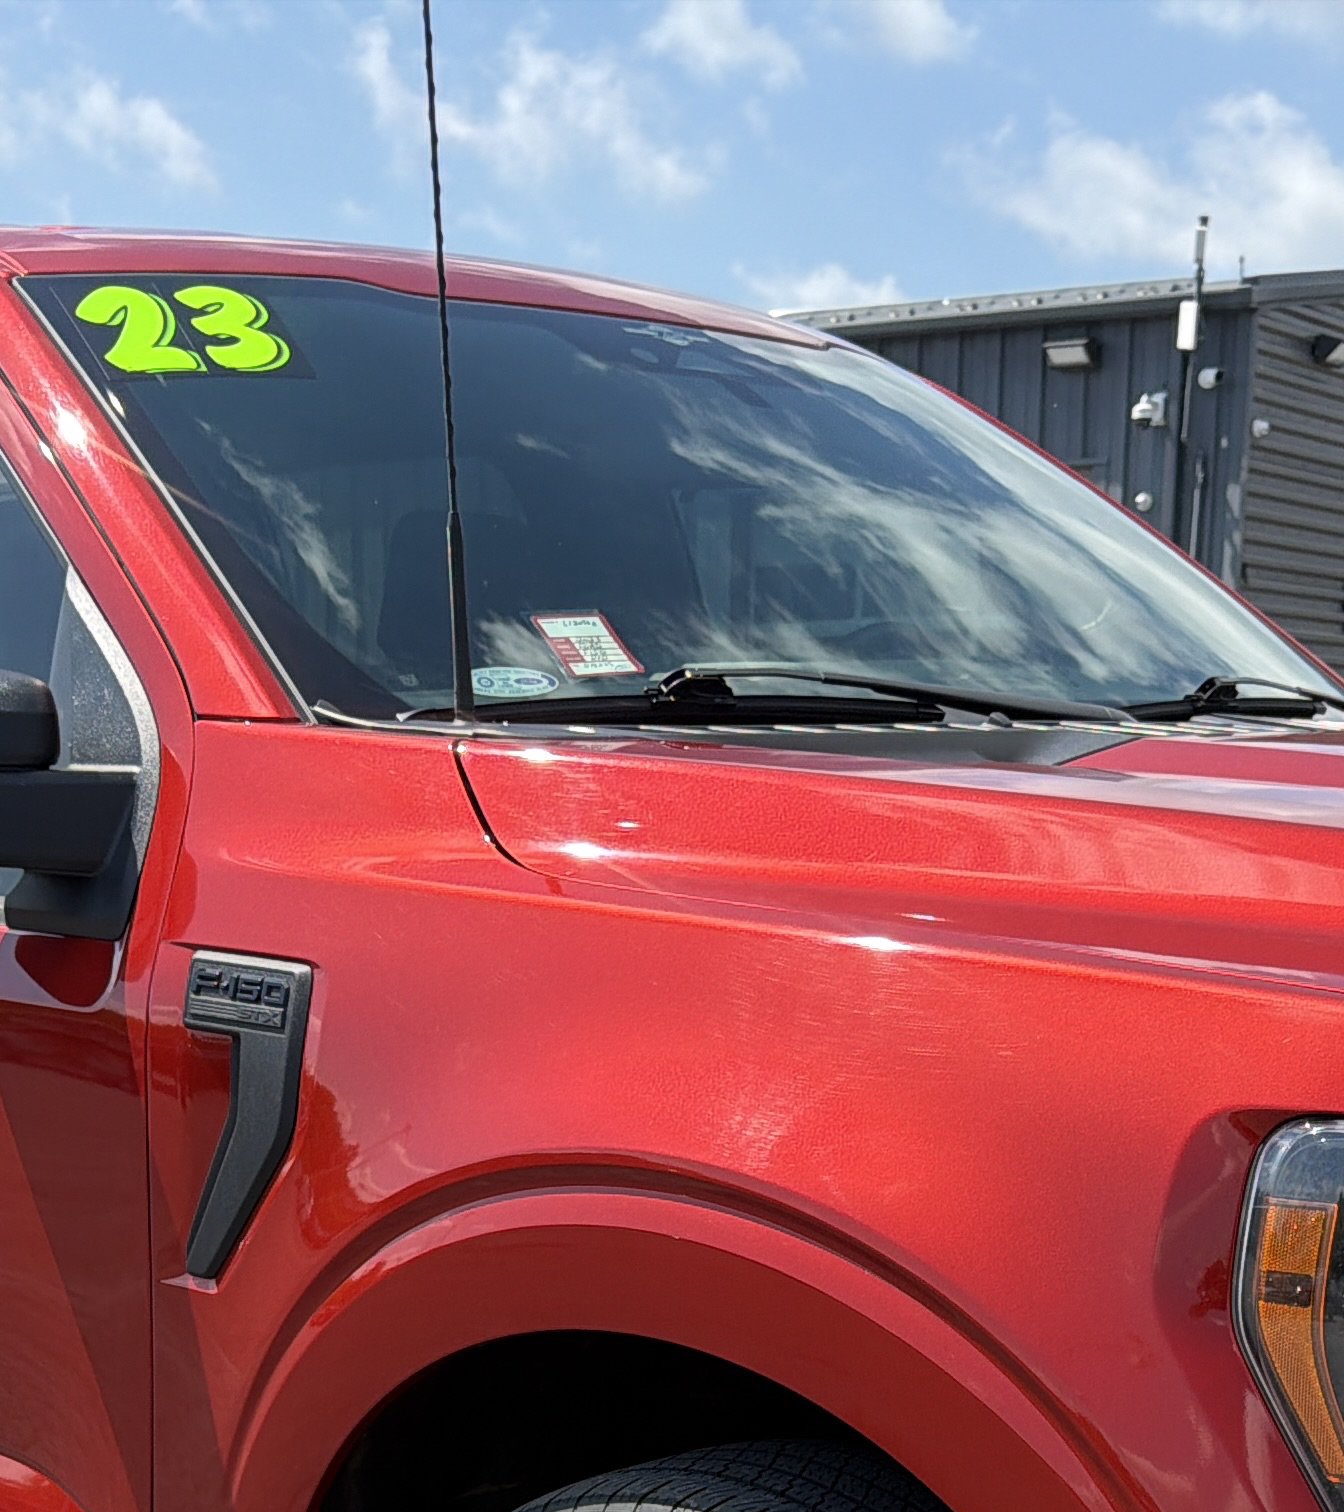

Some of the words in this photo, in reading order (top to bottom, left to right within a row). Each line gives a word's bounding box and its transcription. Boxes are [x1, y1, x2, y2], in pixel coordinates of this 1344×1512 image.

[74, 285, 291, 373] 23
[190, 967, 291, 1006] F-150
[236, 1005, 283, 1027] STX
